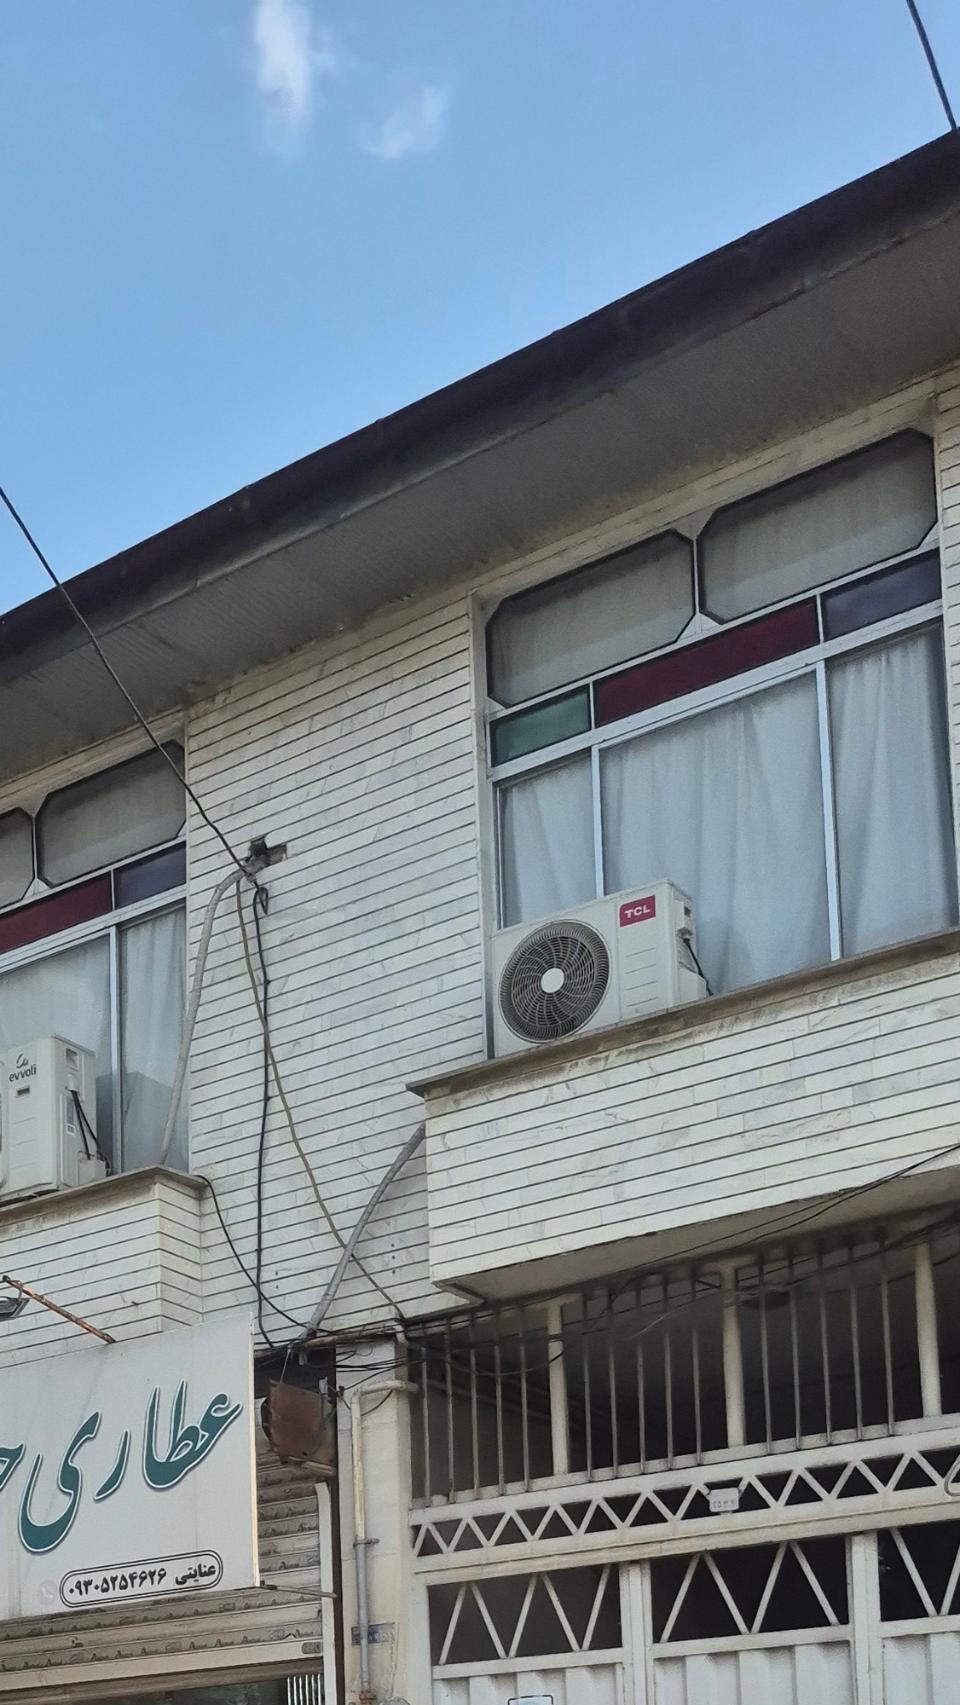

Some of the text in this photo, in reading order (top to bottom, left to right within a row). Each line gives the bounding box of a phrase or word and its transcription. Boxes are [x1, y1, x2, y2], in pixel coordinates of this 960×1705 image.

[624, 905, 651, 919] TCL
[8, 1063, 38, 1083] evvoli
[18, 1379, 244, 1553] عطاری
[68, 1563, 217, 1596] عنایتی ۰۹۳۰۵۲۵۴۶۲۶
